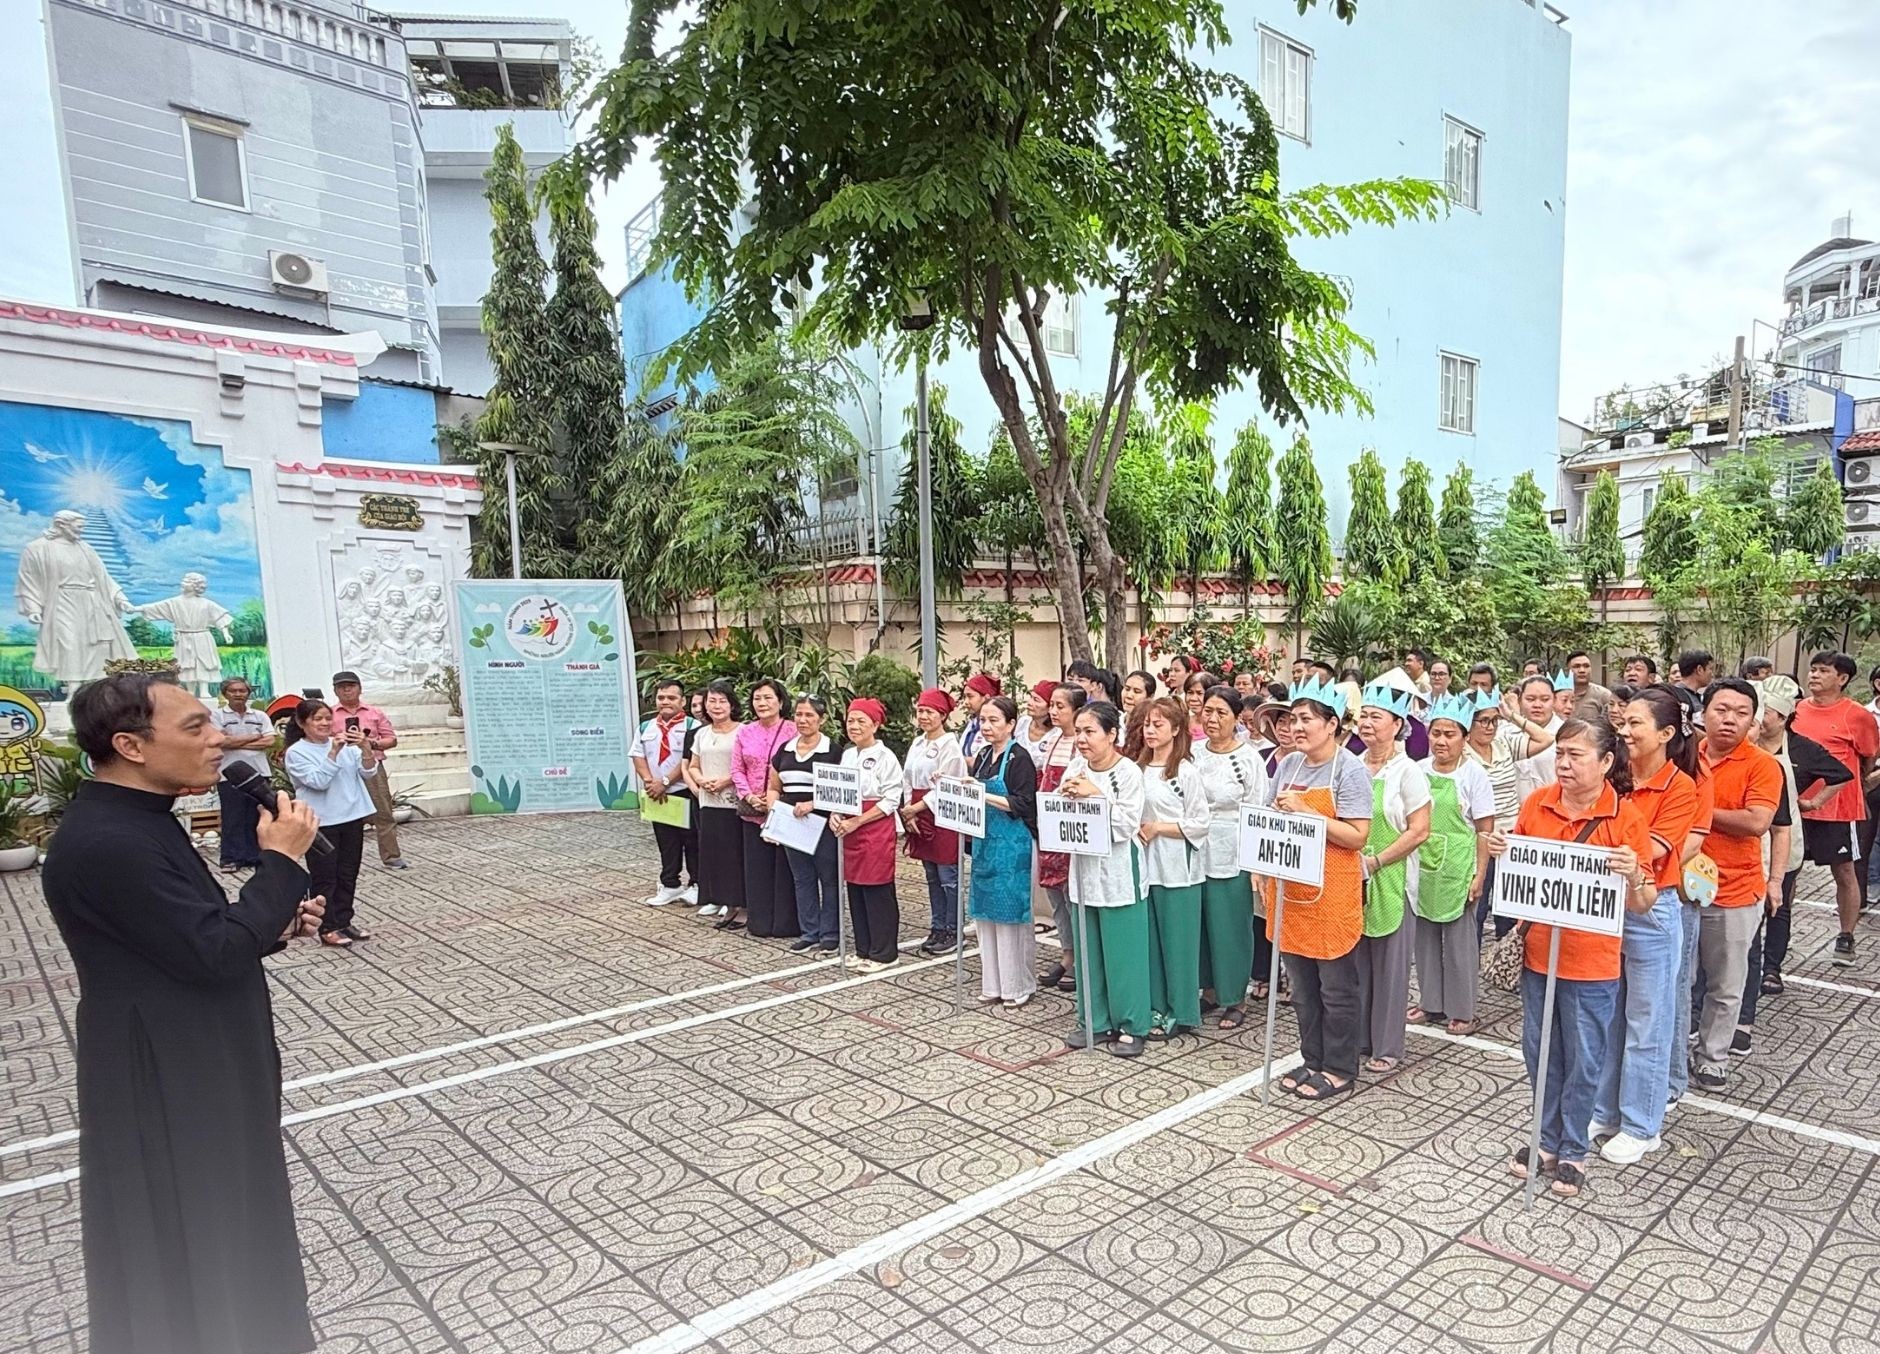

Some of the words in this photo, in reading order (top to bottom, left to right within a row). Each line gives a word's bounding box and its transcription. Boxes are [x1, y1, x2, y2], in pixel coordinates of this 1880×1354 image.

[818, 768, 829, 780] GIÁO
[829, 770, 839, 781] KHU
[840, 771, 856, 783] THÁNH
[952, 784, 962, 796] KHU
[962, 785, 979, 800] THÁNH
[1044, 798, 1061, 812] GIÁO
[1062, 801, 1076, 814] KHU
[1077, 800, 1102, 815] THÁNH
[1059, 820, 1089, 844] GIUSE
[1247, 812, 1267, 829] GIÁO
[1269, 817, 1286, 833] KHU
[1288, 820, 1316, 838] THÁNH
[1258, 837, 1302, 870] AN-TÔN
[1510, 845, 1538, 866] GIÁO
[1541, 850, 1566, 870] KHU
[1501, 872, 1537, 906] VINH
[1540, 878, 1573, 912] SƠN
[1577, 880, 1617, 920] LIÊM
